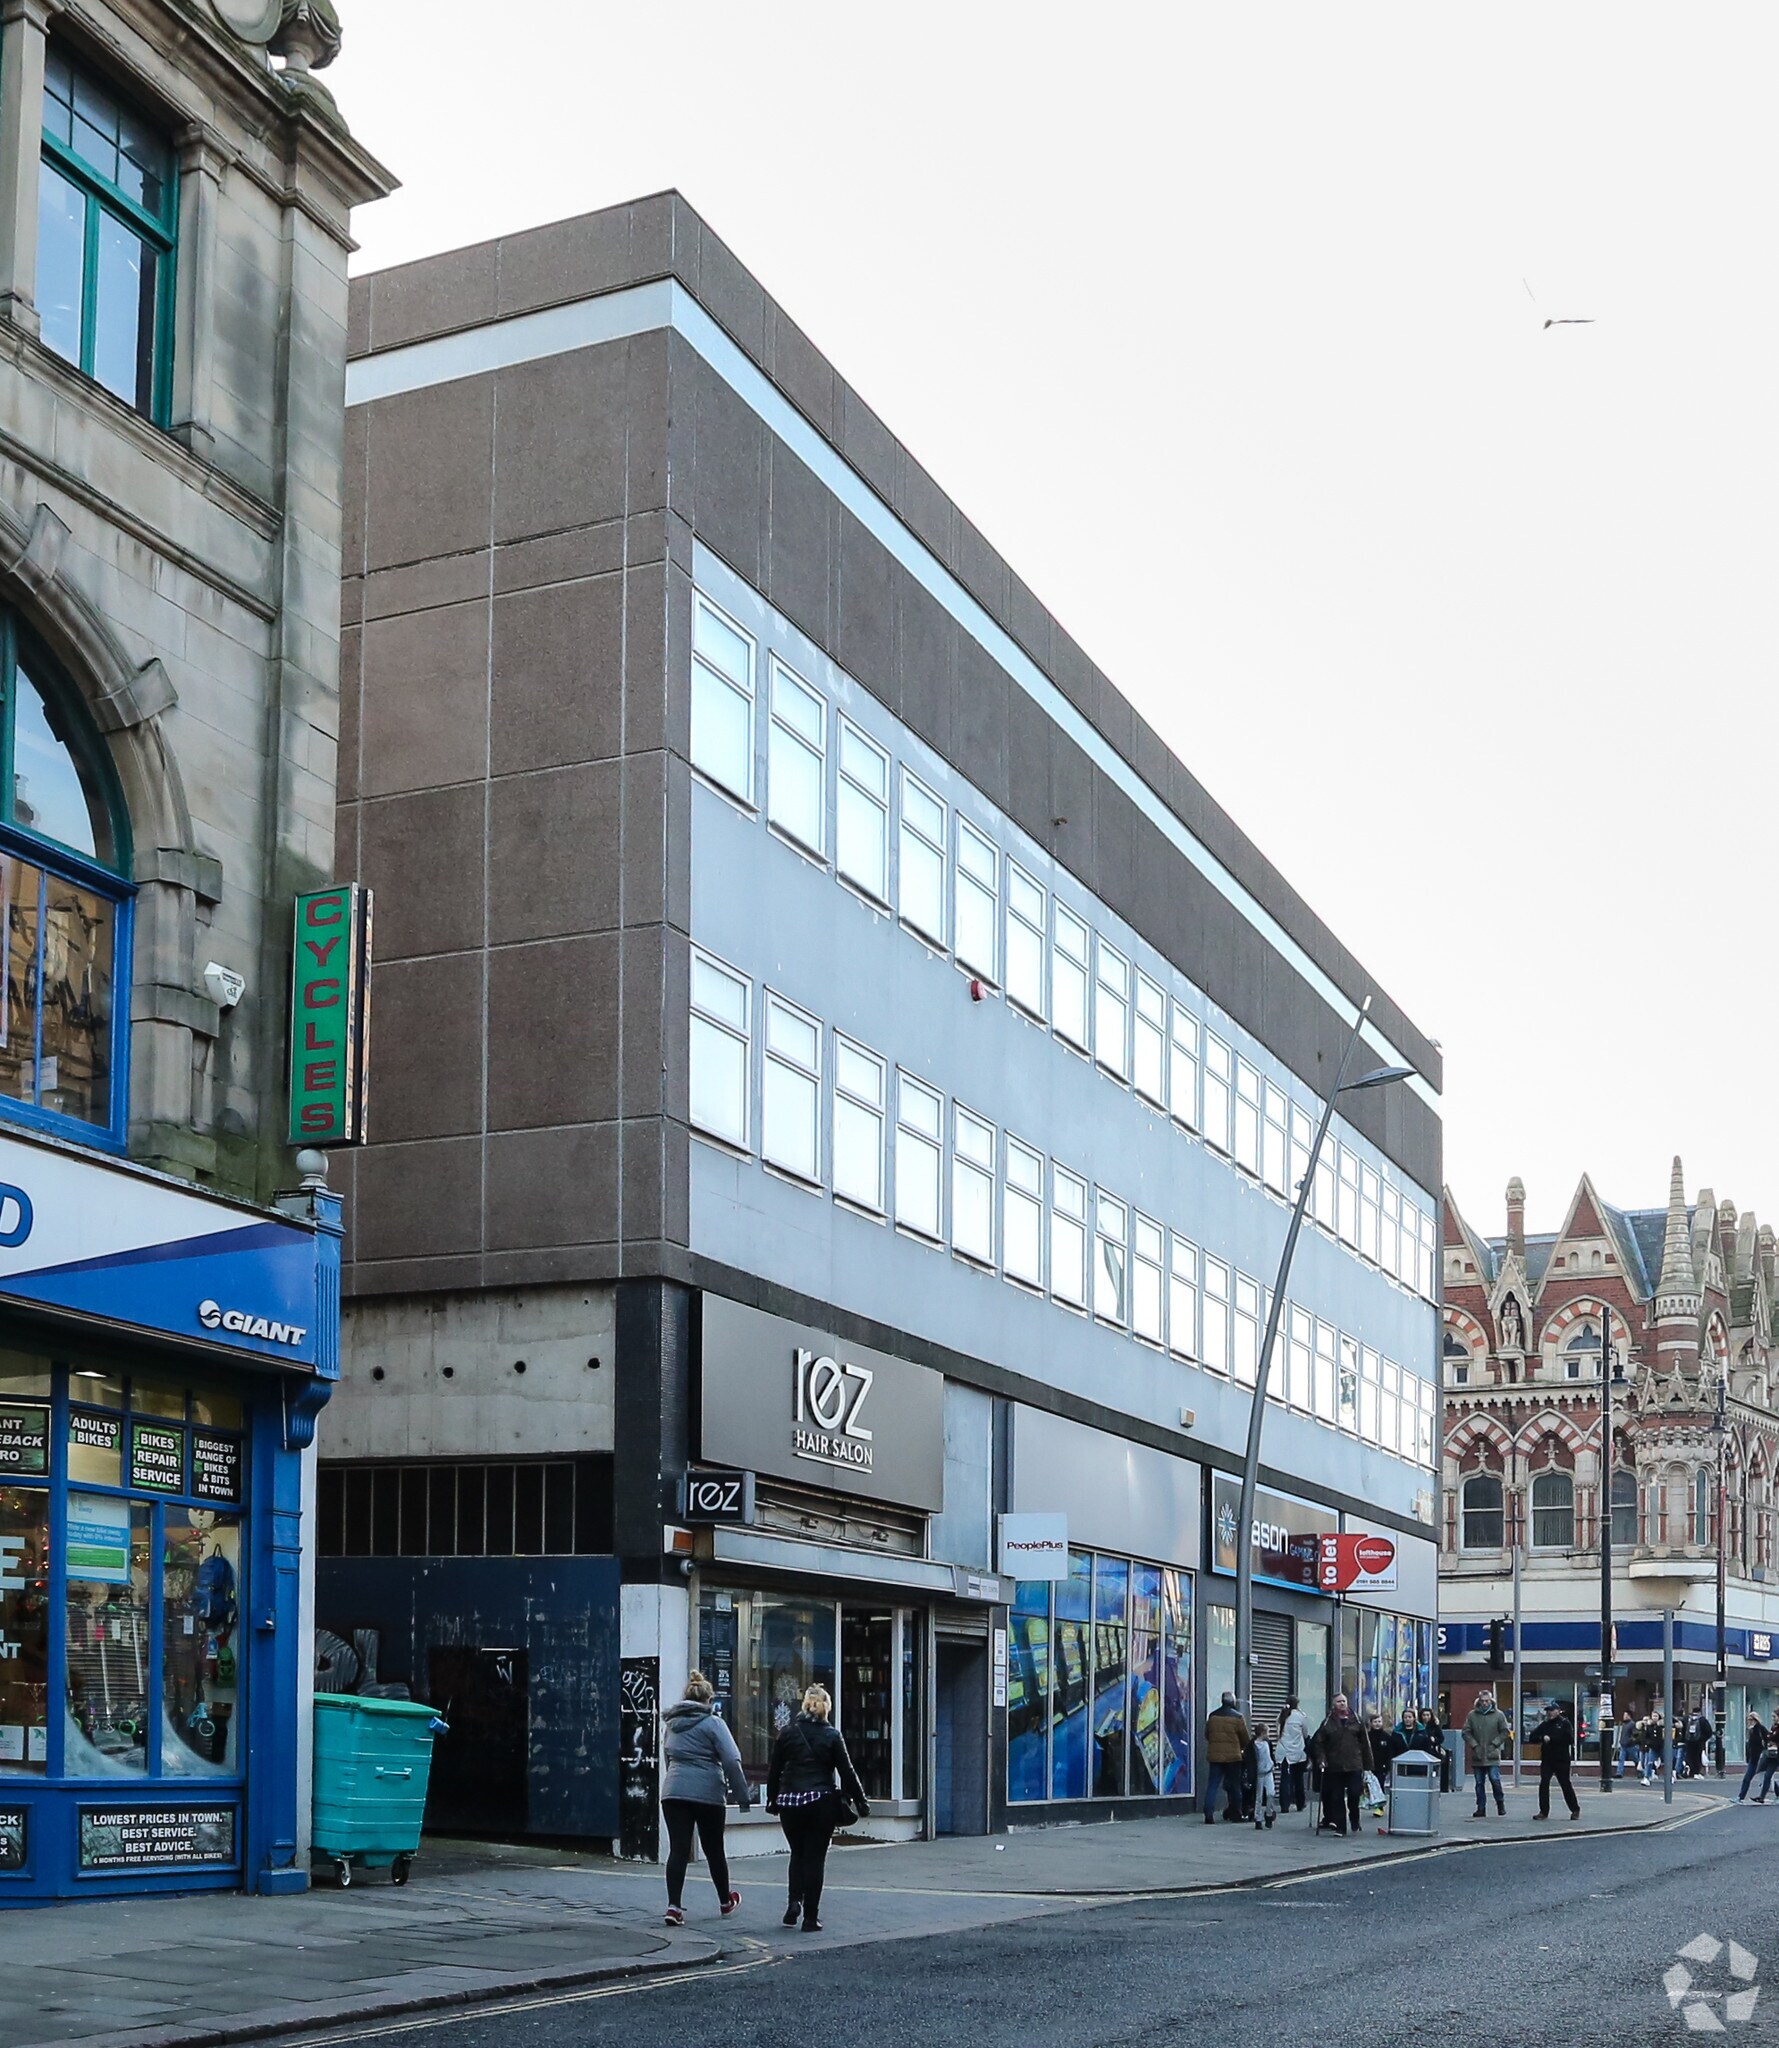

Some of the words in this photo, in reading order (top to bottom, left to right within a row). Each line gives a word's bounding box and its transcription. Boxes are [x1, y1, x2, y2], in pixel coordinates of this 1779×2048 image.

[300, 896, 343, 1133] CYCLES
[222, 1311, 306, 1345] GIANT
[72, 1417, 117, 1435] ADULTS
[77, 1431, 112, 1447] BIKES
[141, 1433, 174, 1449] BIKES
[198, 1439, 234, 1453] BIGGEST
[796, 1429, 829, 1454] HAIR
[832, 1438, 873, 1466] SALON
[137, 1450, 177, 1467] REPAIR
[196, 1450, 224, 1464] RANGE
[226, 1456, 236, 1464] OF
[204, 1462, 229, 1474] BIKES
[133, 1467, 181, 1485] SERVICE
[202, 1473, 209, 1482] &
[211, 1474, 230, 1485] BITS
[198, 1483, 208, 1493] IN
[209, 1485, 234, 1497] TOWN
[1007, 1541, 1064, 1551] PeoplePlus
[93, 1814, 137, 1826] LOWEST
[139, 1813, 176, 1825] PRICES
[178, 1813, 189, 1823] IN
[192, 1813, 223, 1823] TOWN.
[122, 1828, 150, 1839] BEST
[151, 1827, 197, 1838] SERVICE.
[125, 1842, 152, 1853] BEST
[154, 1841, 194, 1852] ADVICE.
